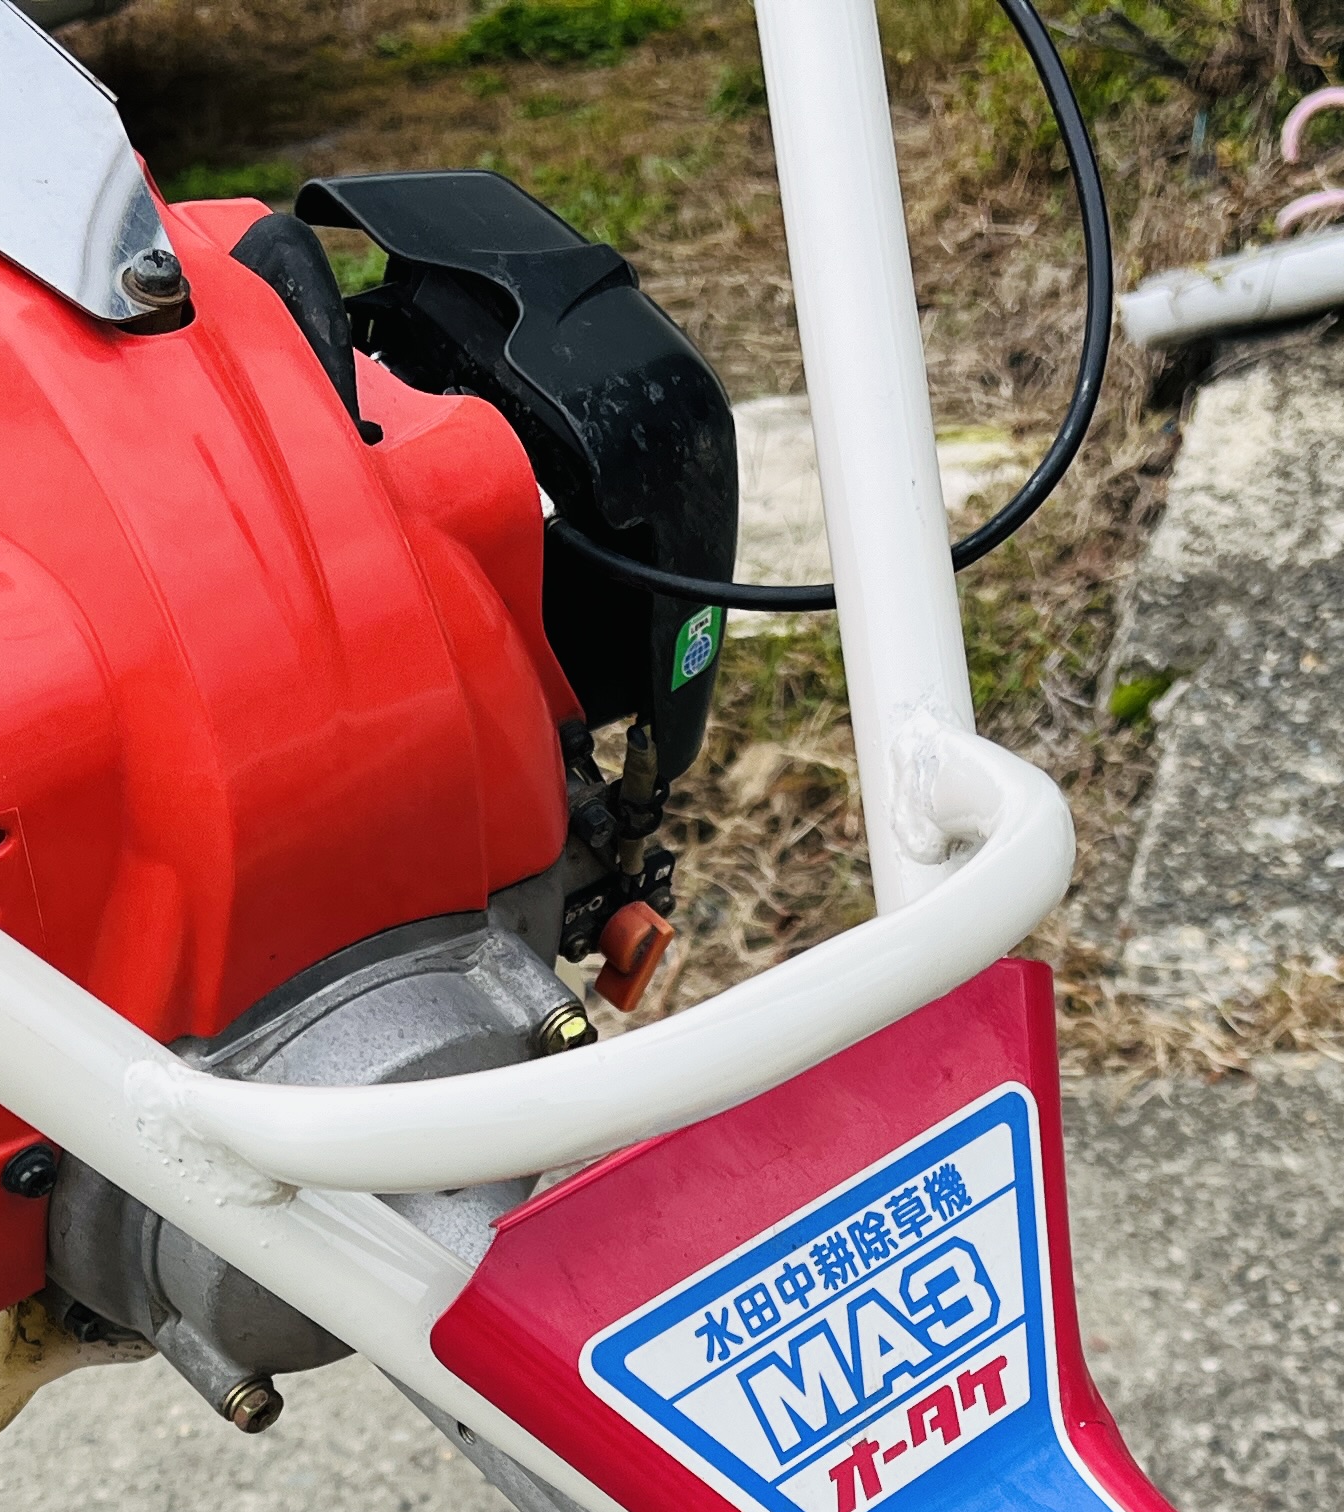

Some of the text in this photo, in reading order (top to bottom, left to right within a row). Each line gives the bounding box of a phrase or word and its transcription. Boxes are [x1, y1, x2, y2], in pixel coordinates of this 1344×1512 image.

[695, 1162, 973, 1364] 水田中耕除草機
[736, 1236, 1001, 1466] MA3
